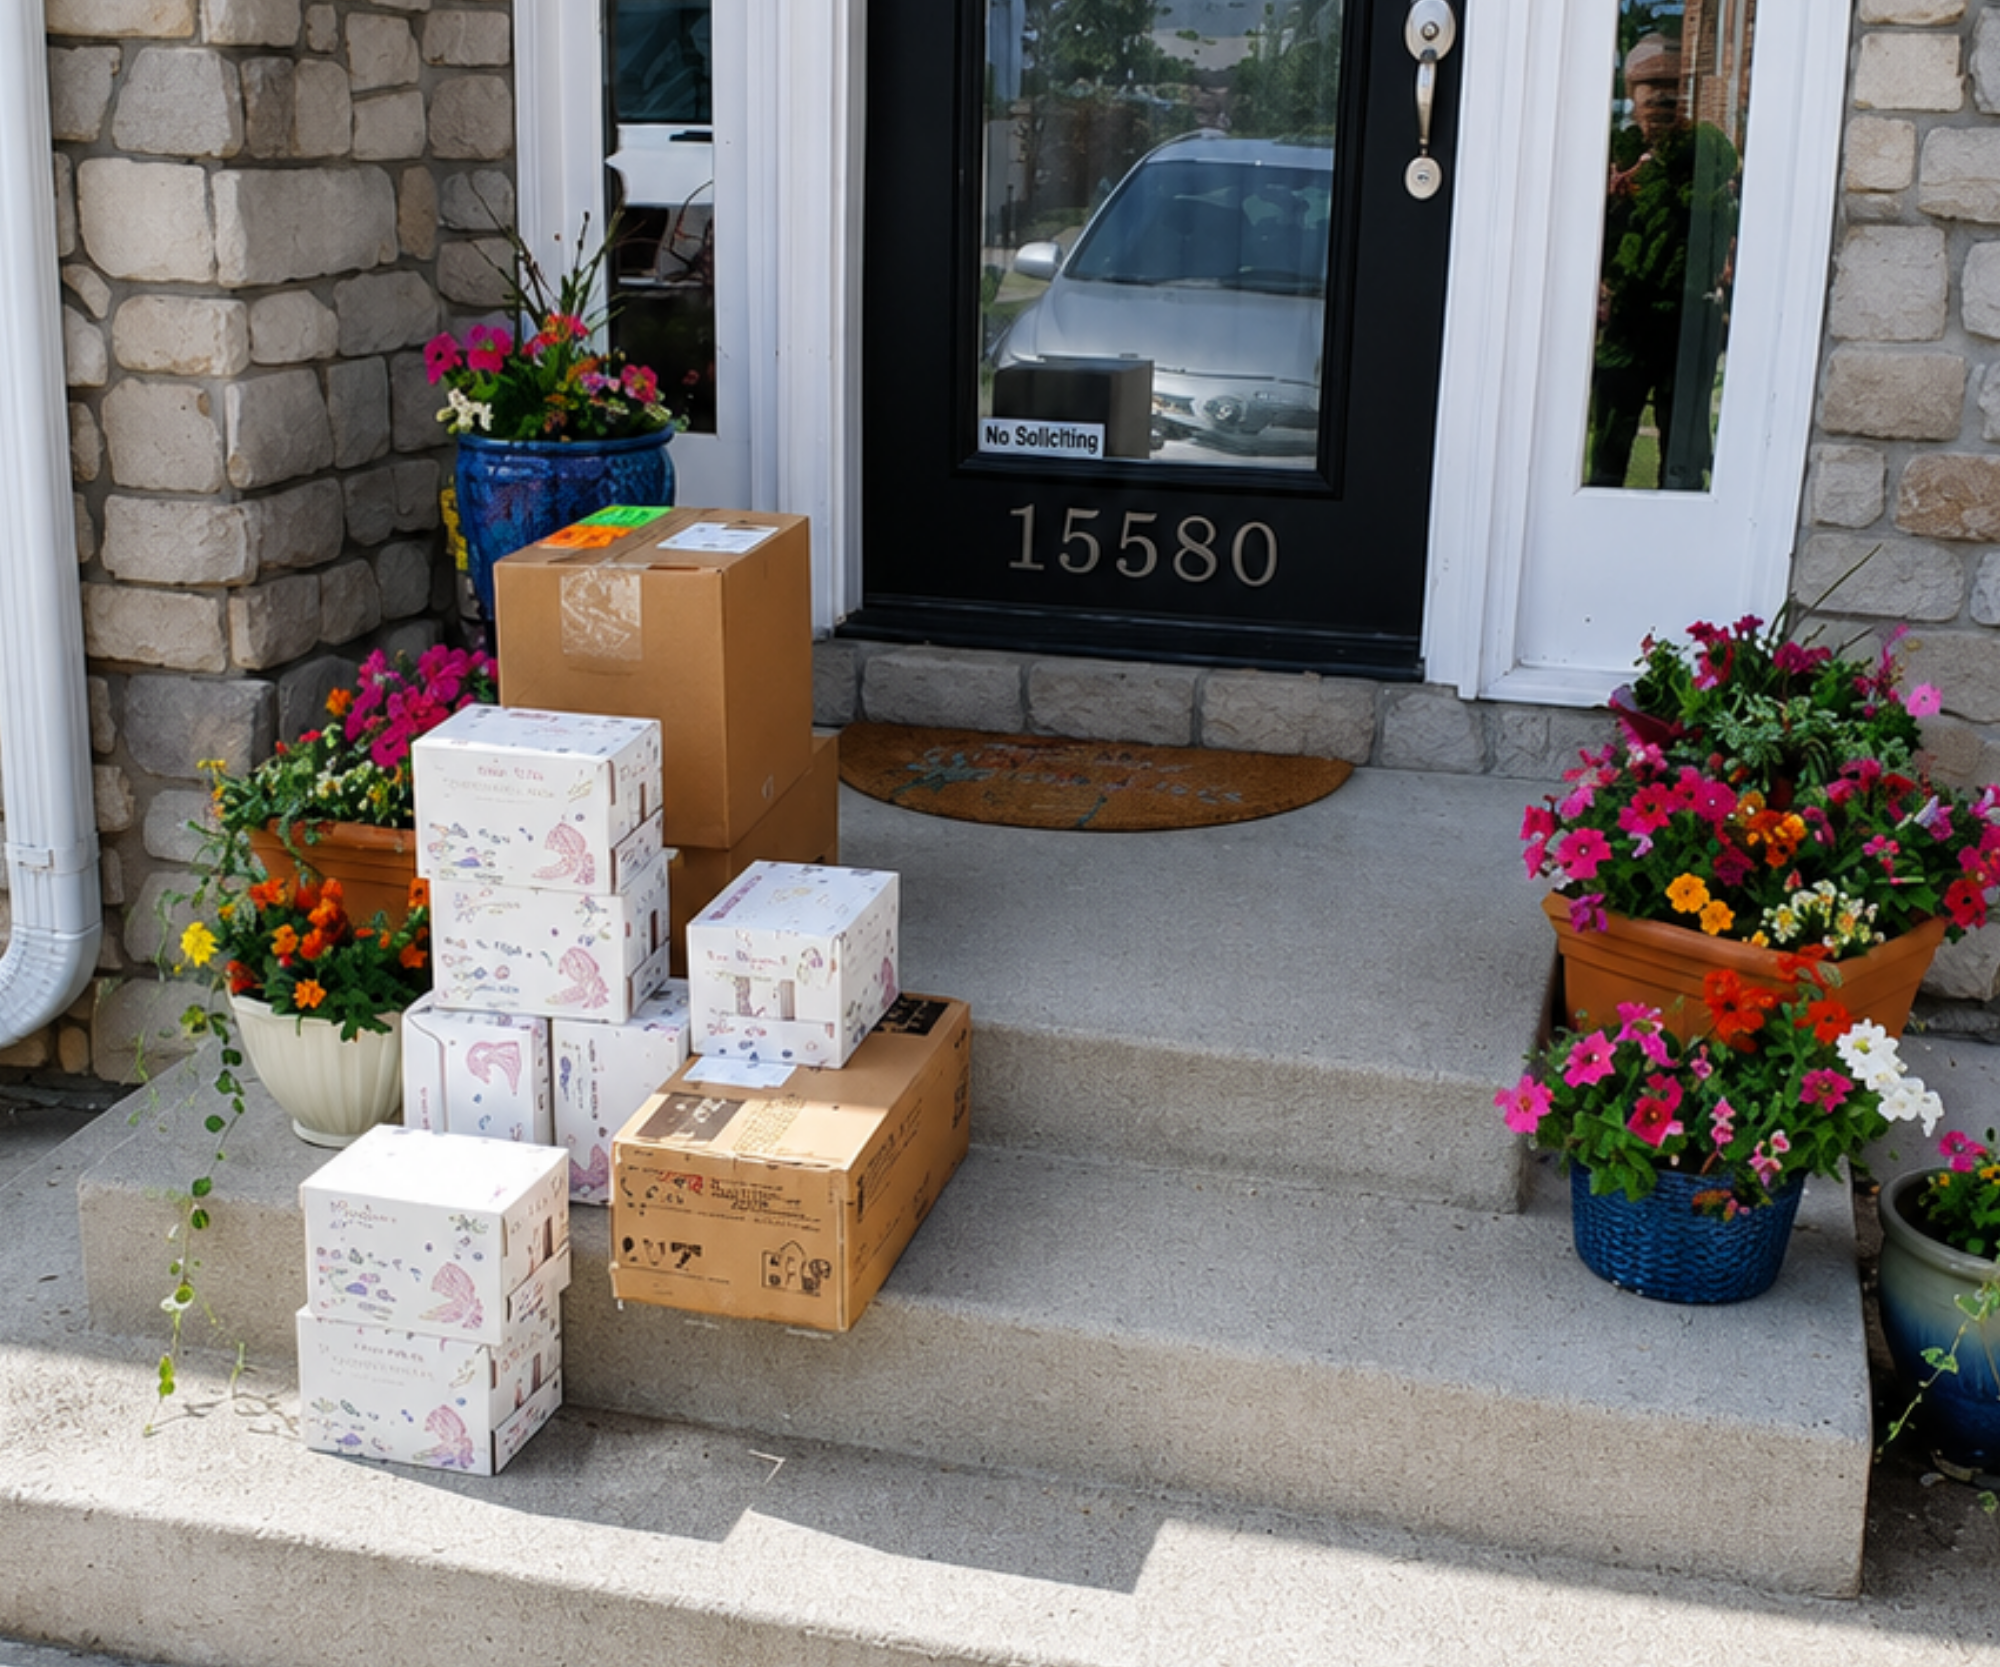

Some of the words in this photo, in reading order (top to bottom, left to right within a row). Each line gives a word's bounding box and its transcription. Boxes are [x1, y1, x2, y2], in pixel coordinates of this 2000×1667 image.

[986, 425, 1009, 446] No
[1015, 426, 1098, 454] Soliciting
[1008, 503, 1277, 587] 15580
